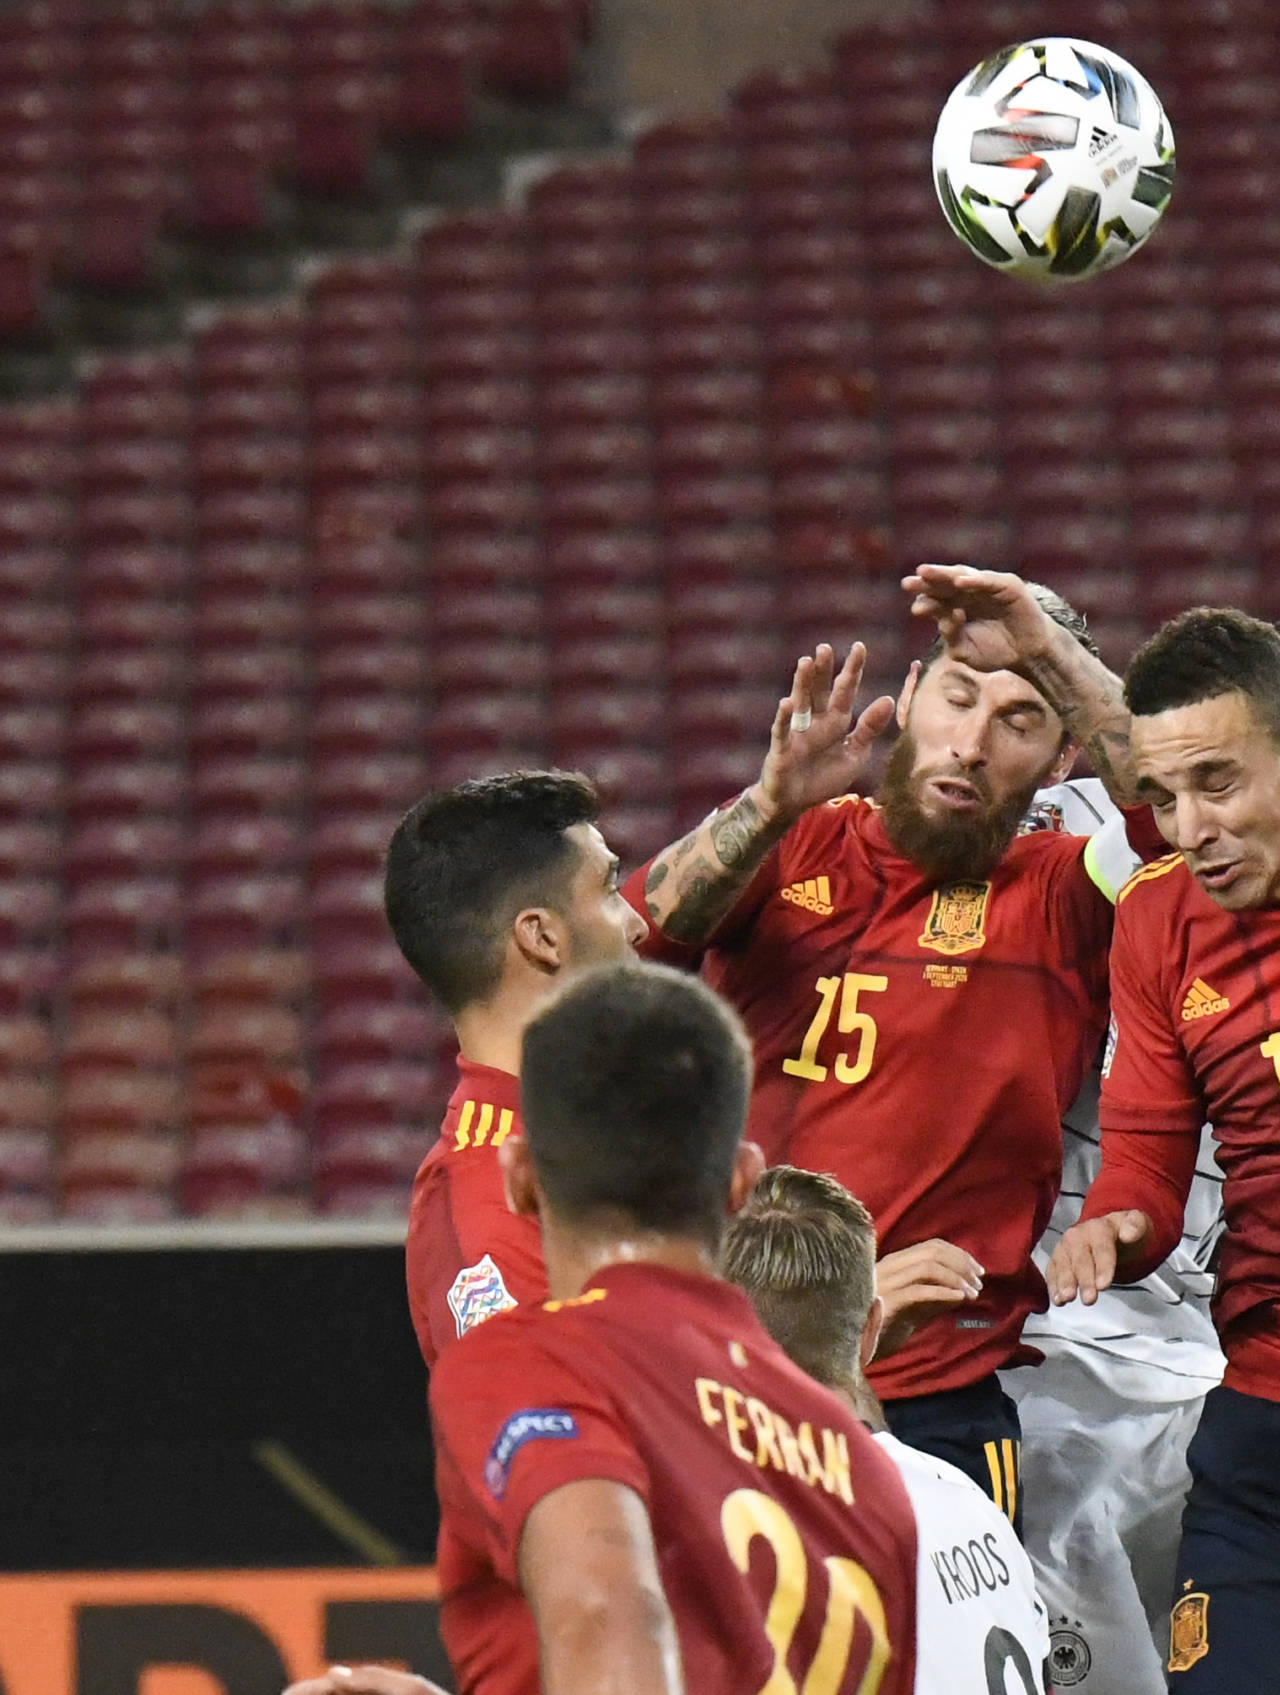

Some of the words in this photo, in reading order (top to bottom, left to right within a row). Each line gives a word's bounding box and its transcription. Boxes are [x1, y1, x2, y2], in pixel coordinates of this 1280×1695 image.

[781, 888, 834, 916] adidas
[782, 972, 888, 1084] 15
[1182, 998, 1230, 1021] adidas
[695, 1378, 855, 1506] FERRAN
[929, 1532, 1010, 1605] KROOS
